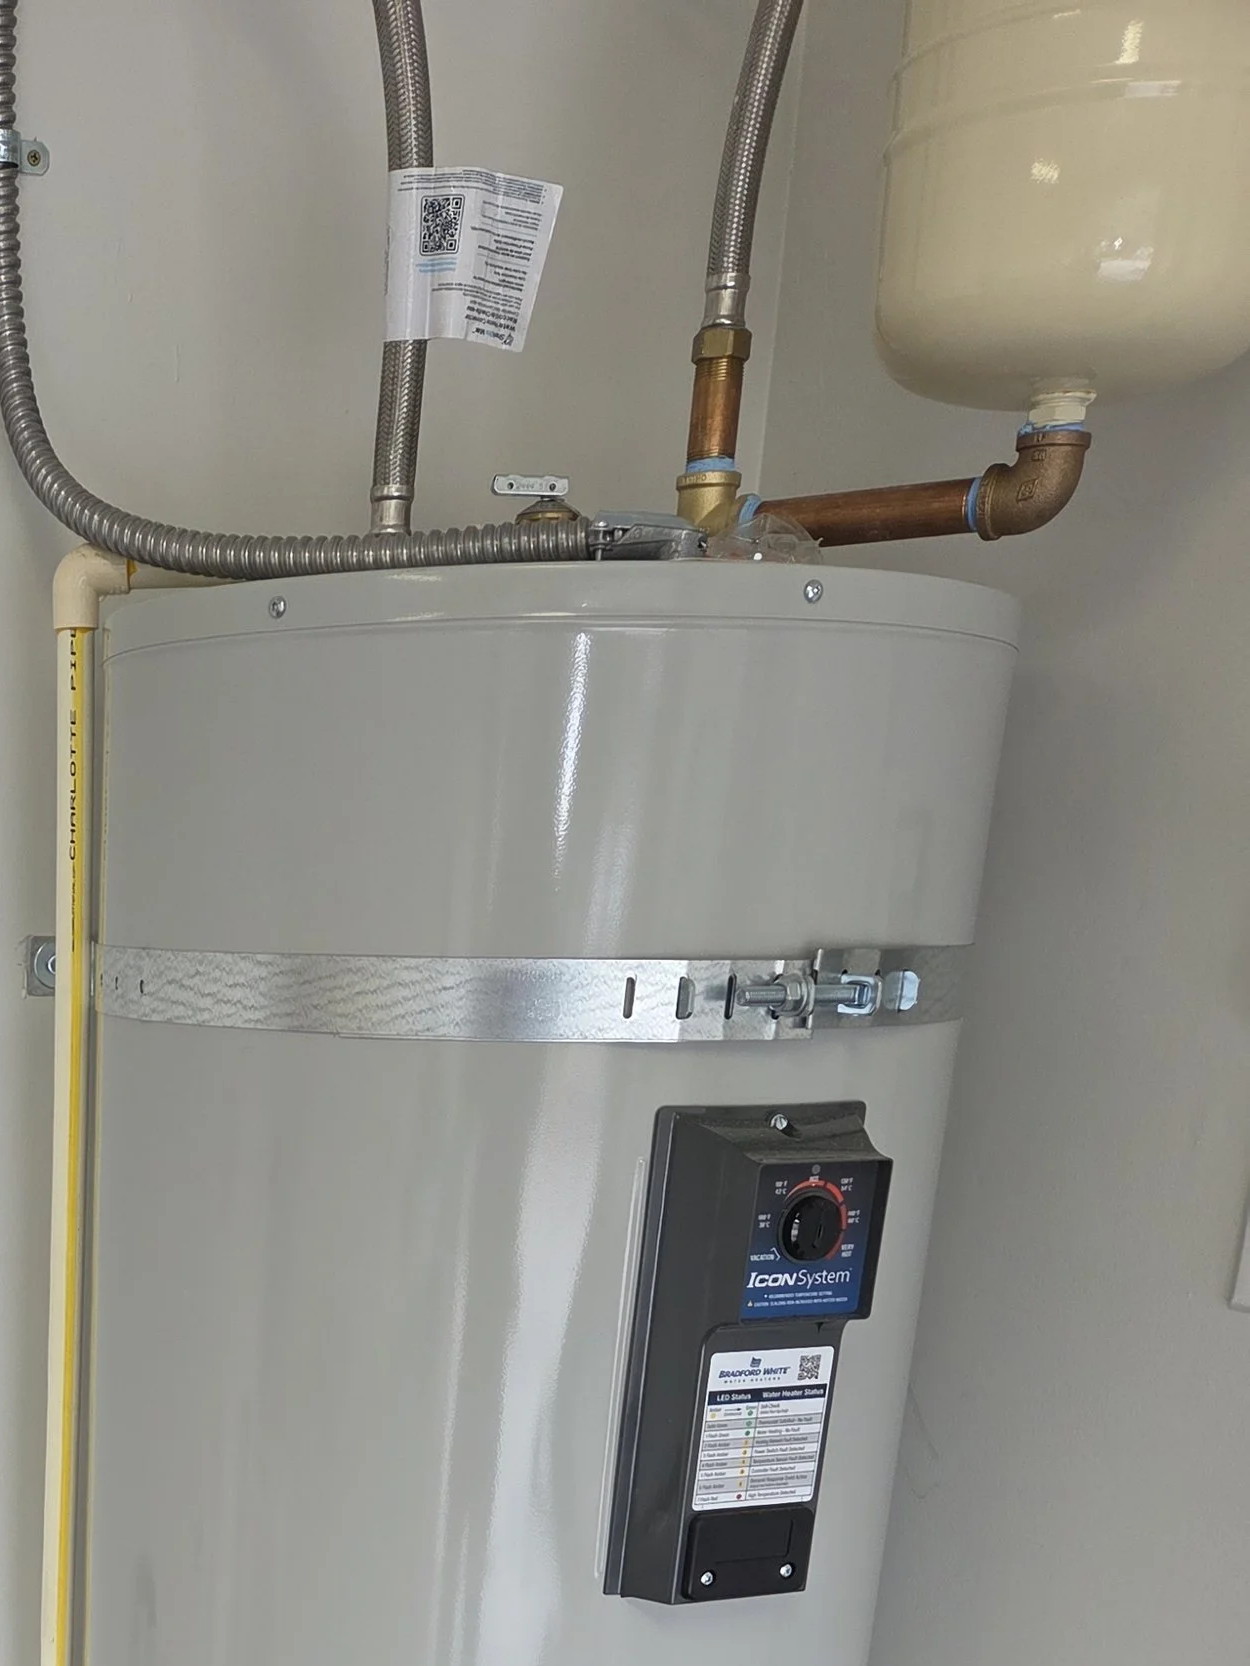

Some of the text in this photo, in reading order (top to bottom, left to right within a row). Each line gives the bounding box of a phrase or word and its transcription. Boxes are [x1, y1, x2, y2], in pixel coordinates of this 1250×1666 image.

[68, 709, 77, 862] CHARLOTTE
[718, 1366, 789, 1379] BRADFORD WHITE
[762, 1387, 824, 1398] Water Heater Status
